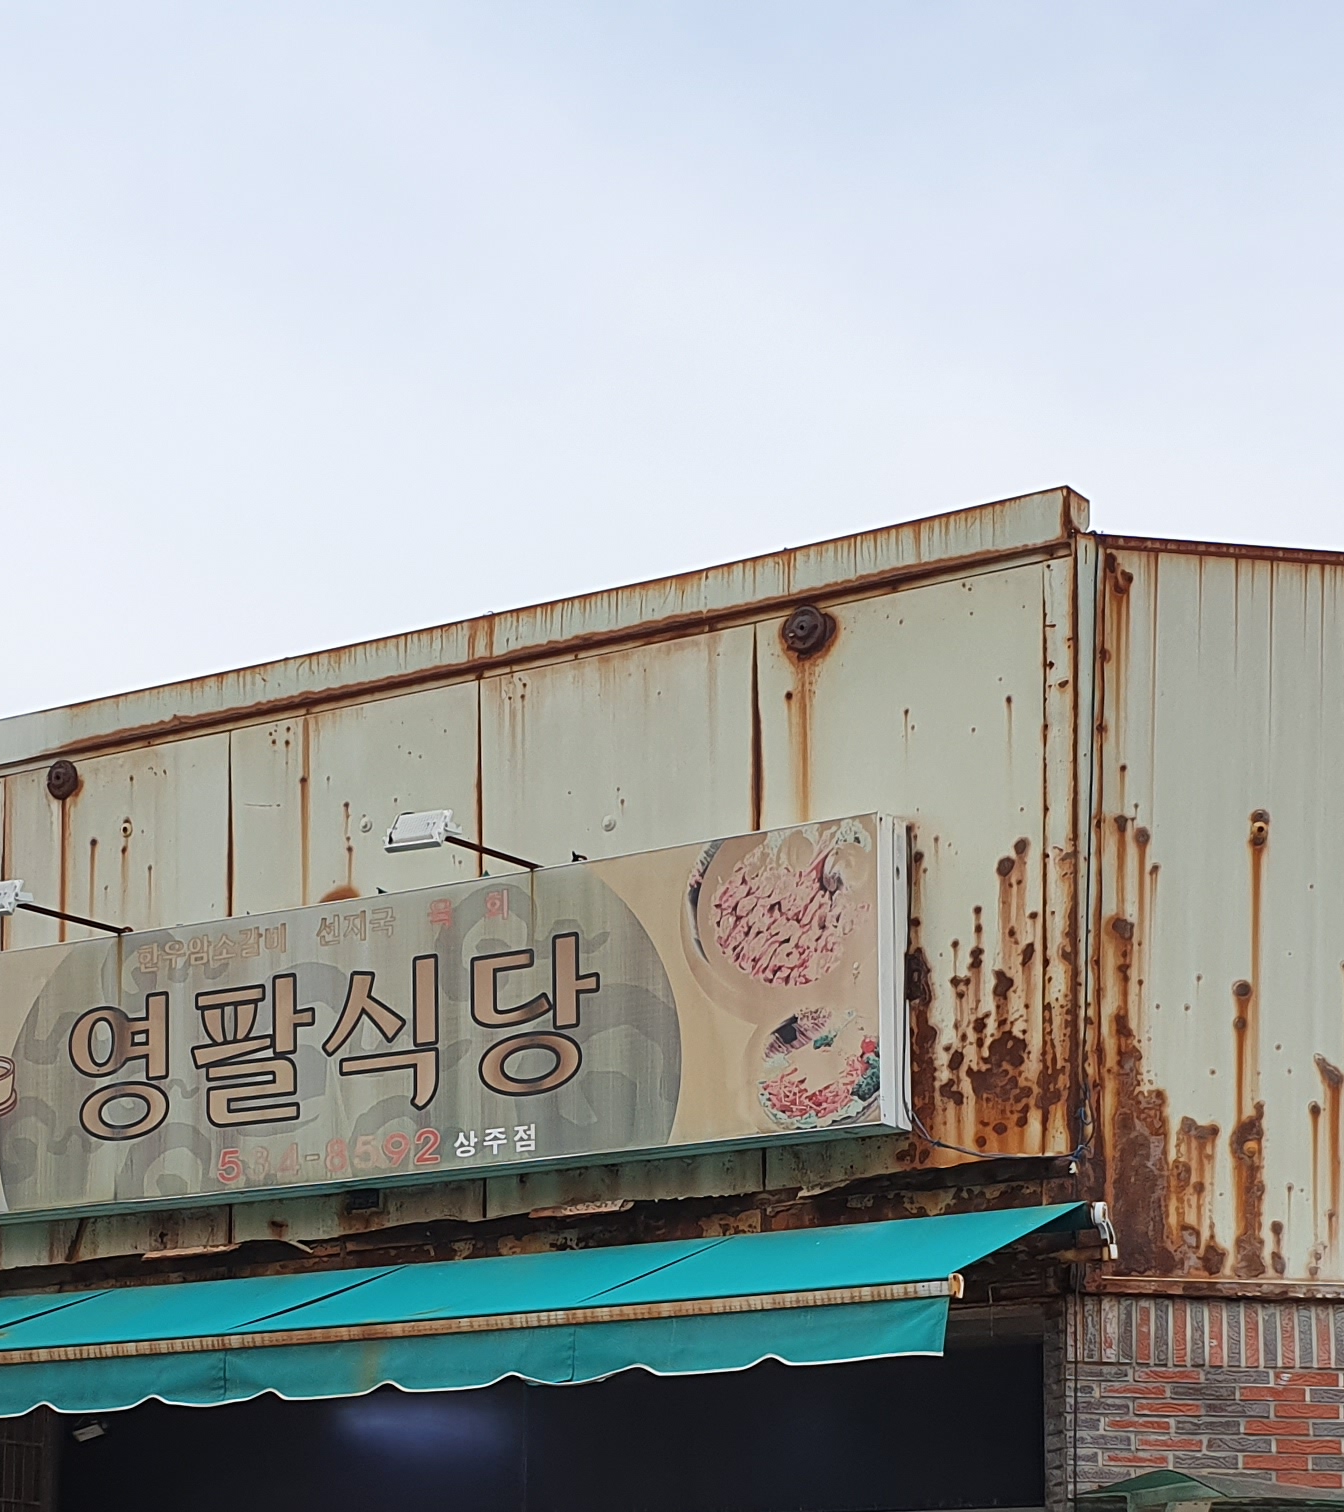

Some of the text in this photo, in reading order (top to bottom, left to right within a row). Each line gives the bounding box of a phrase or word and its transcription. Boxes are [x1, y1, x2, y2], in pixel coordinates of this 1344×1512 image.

[137, 922, 288, 974] 한우암소갈비
[316, 905, 396, 947] 선지국
[68, 931, 601, 1141] 영팔식당
[217, 1123, 536, 1184] 534-8592 상주점
